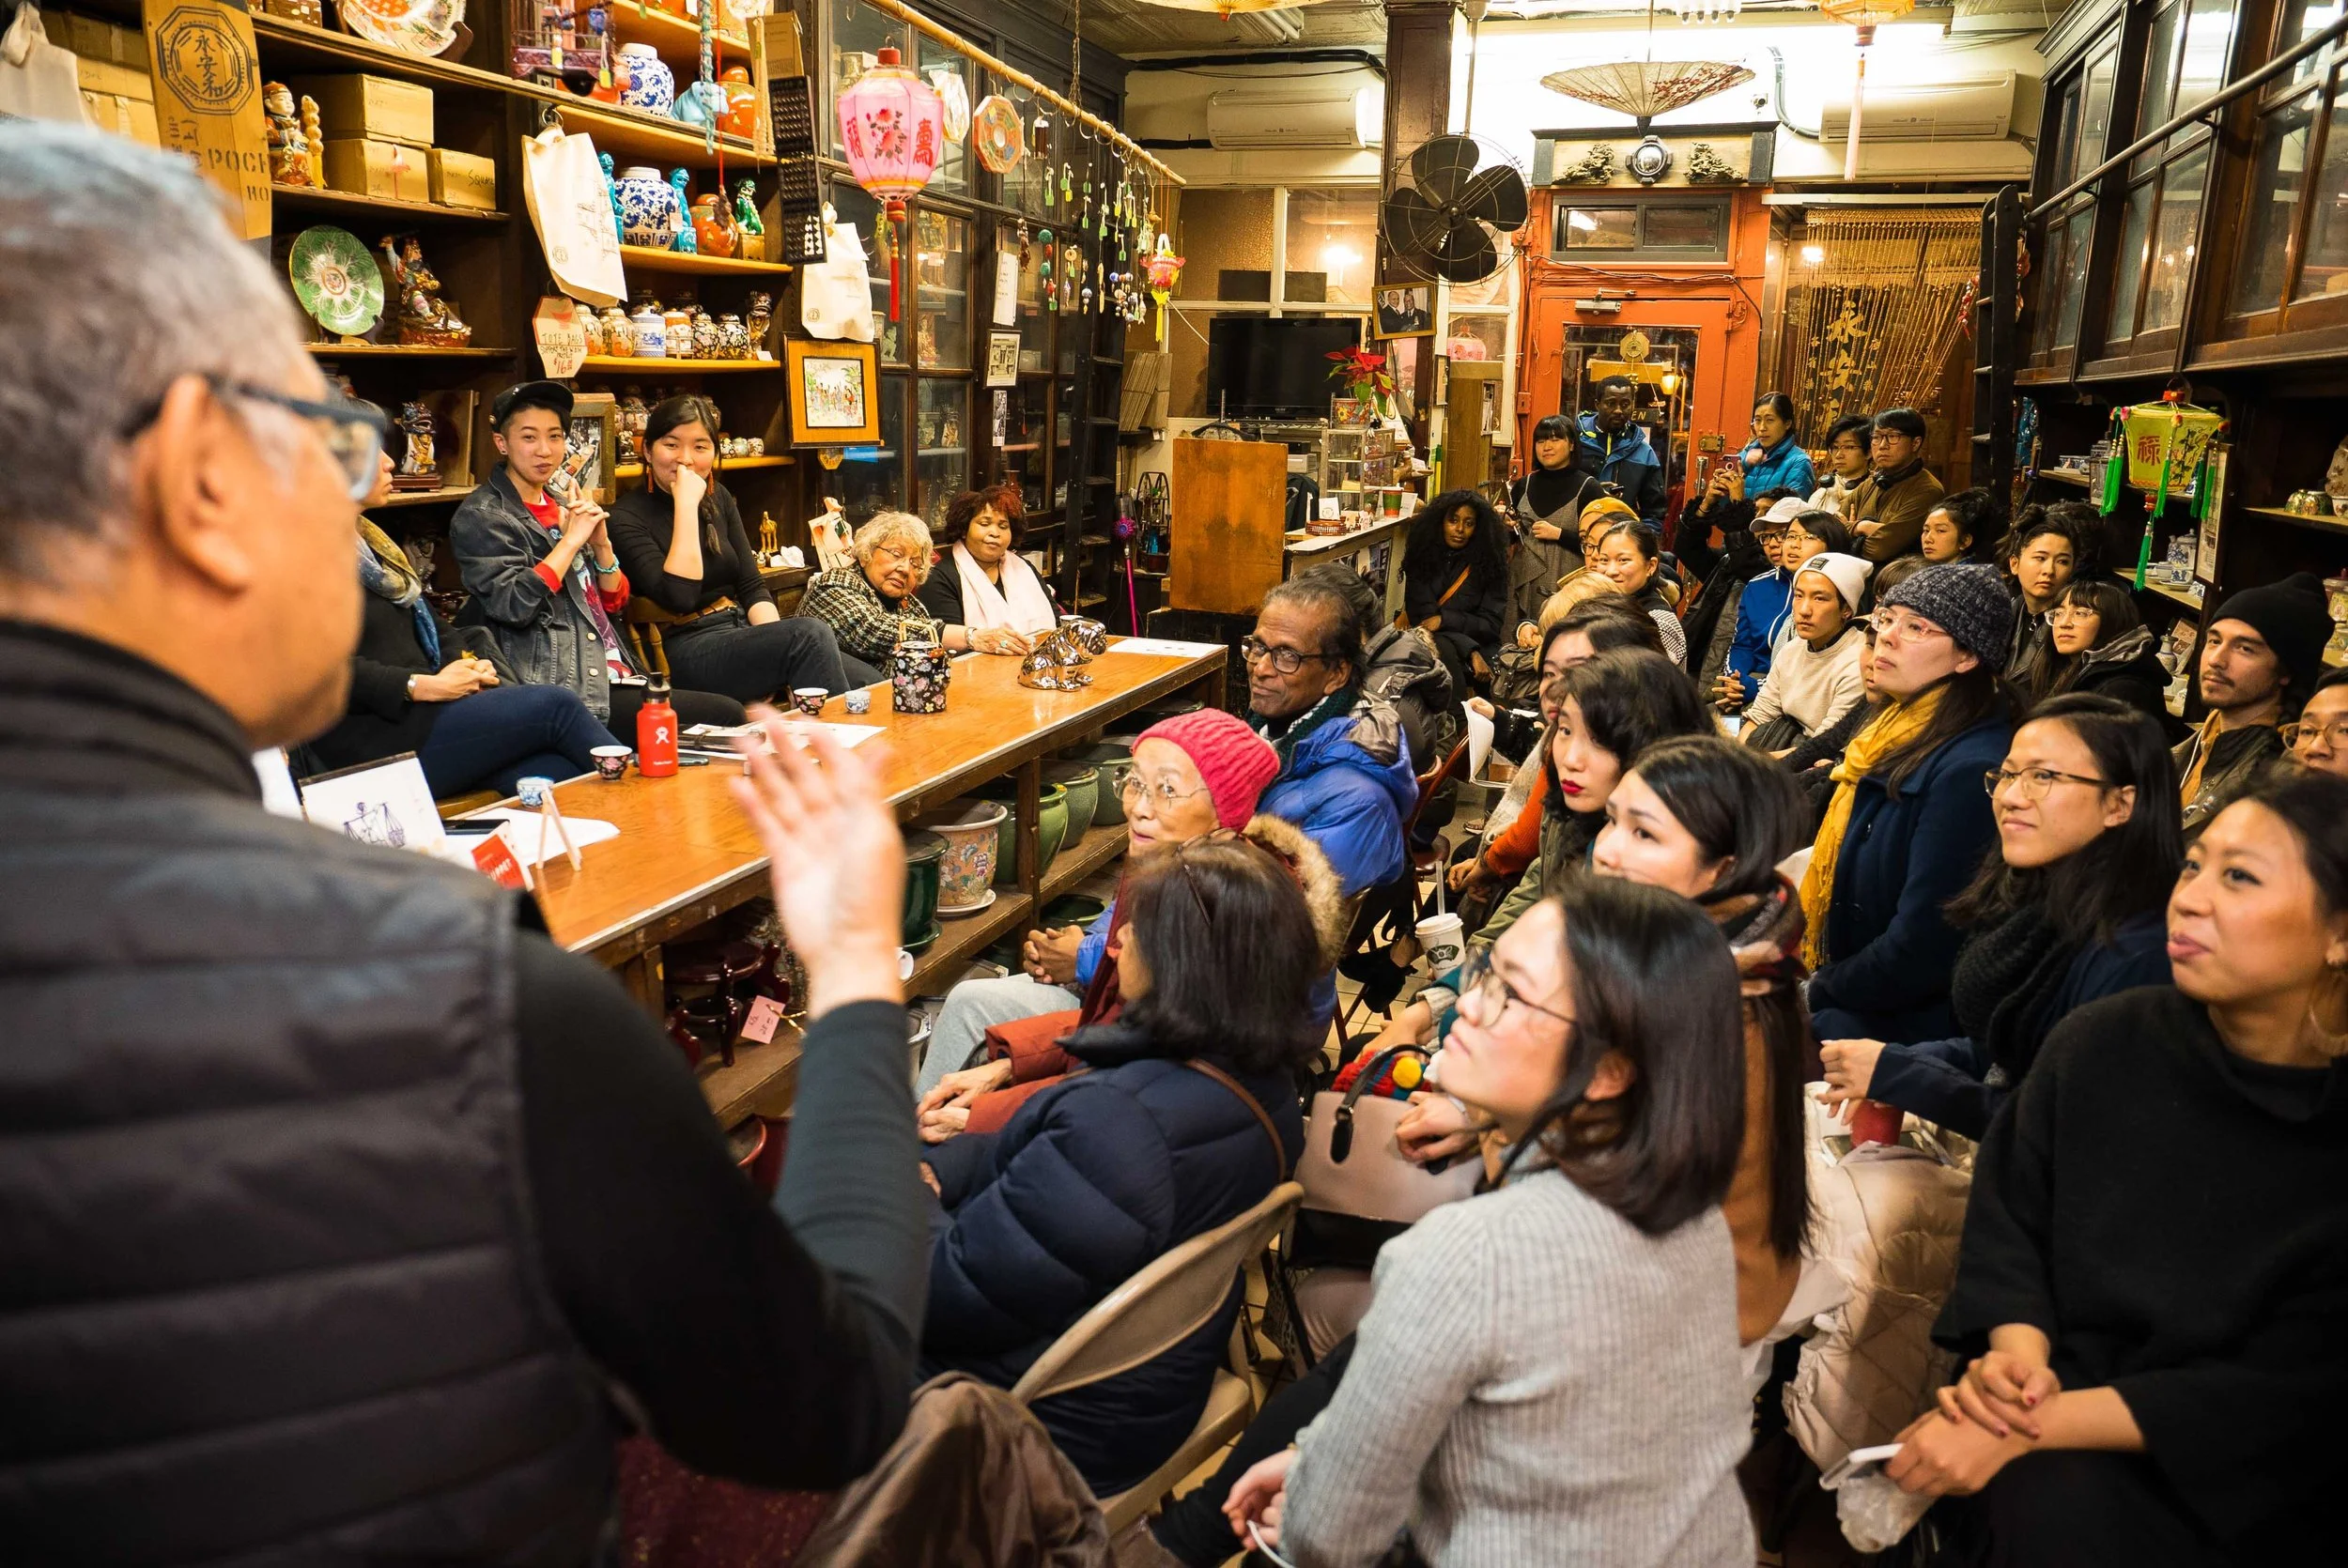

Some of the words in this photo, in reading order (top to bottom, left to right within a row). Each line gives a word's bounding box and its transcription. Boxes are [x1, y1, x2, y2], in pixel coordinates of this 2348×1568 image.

[193, 29, 224, 97] 永安和
[1630, 410, 1646, 421] EN
